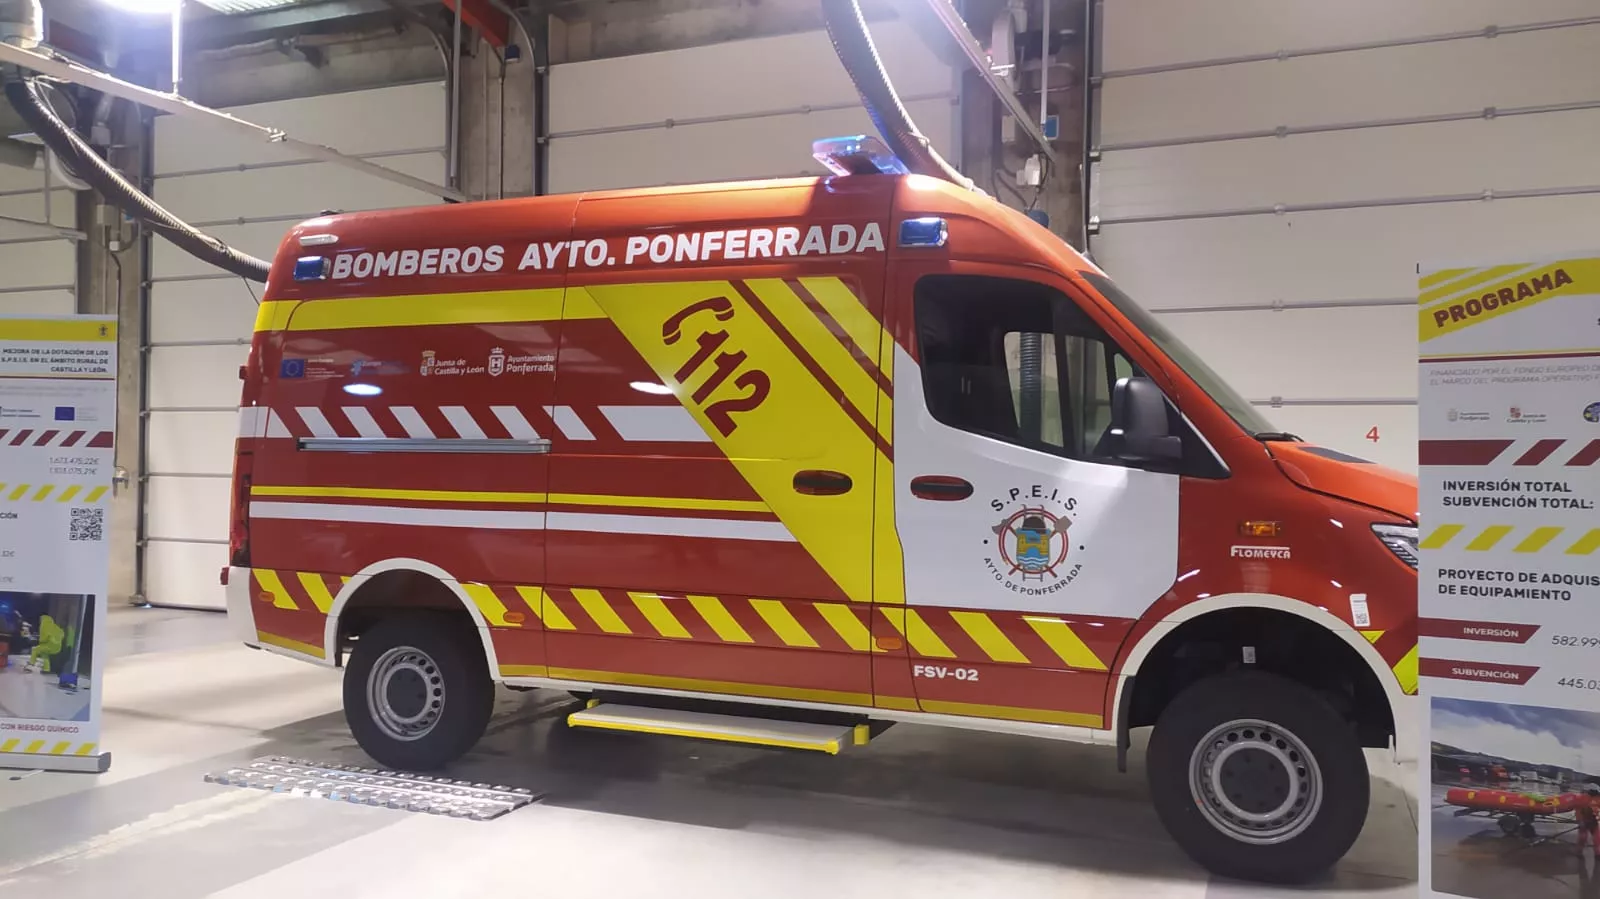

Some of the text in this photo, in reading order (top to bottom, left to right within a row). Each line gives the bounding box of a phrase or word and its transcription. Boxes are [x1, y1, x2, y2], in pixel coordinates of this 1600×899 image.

[332, 222, 886, 280] BOMBEROS AYTO. PONFERRADA
[1433, 268, 1574, 328] PROGRAMA
[435, 358, 466, 367] Junta de
[507, 354, 555, 363] Ayuntamiento
[434, 365, 485, 376] Castilla y León
[506, 363, 554, 375] Ponferrada
[673, 329, 771, 439] 112
[1366, 426, 1380, 443] 4
[1443, 479, 1572, 493] INVERSIÓN TOTAL
[991, 484, 1078, 517] S.P.E.I.S.
[1443, 495, 1594, 510] SUBVENCIÓN TOTAL:
[1005, 580, 1019, 592] DE
[1020, 563, 1083, 596] PONFERRADA
[1438, 568, 1600, 586] PROYECTO DE ADQUIS
[1438, 584, 1572, 601] DE EQUIPAMIENTO
[1463, 627, 1519, 638] INVERSIÓN
[1551, 635, 1600, 648] 582.99
[913, 664, 979, 681] FSV-02
[1452, 667, 1520, 680] SUBVENCIÓN
[17, 724, 46, 732] RIESGO
